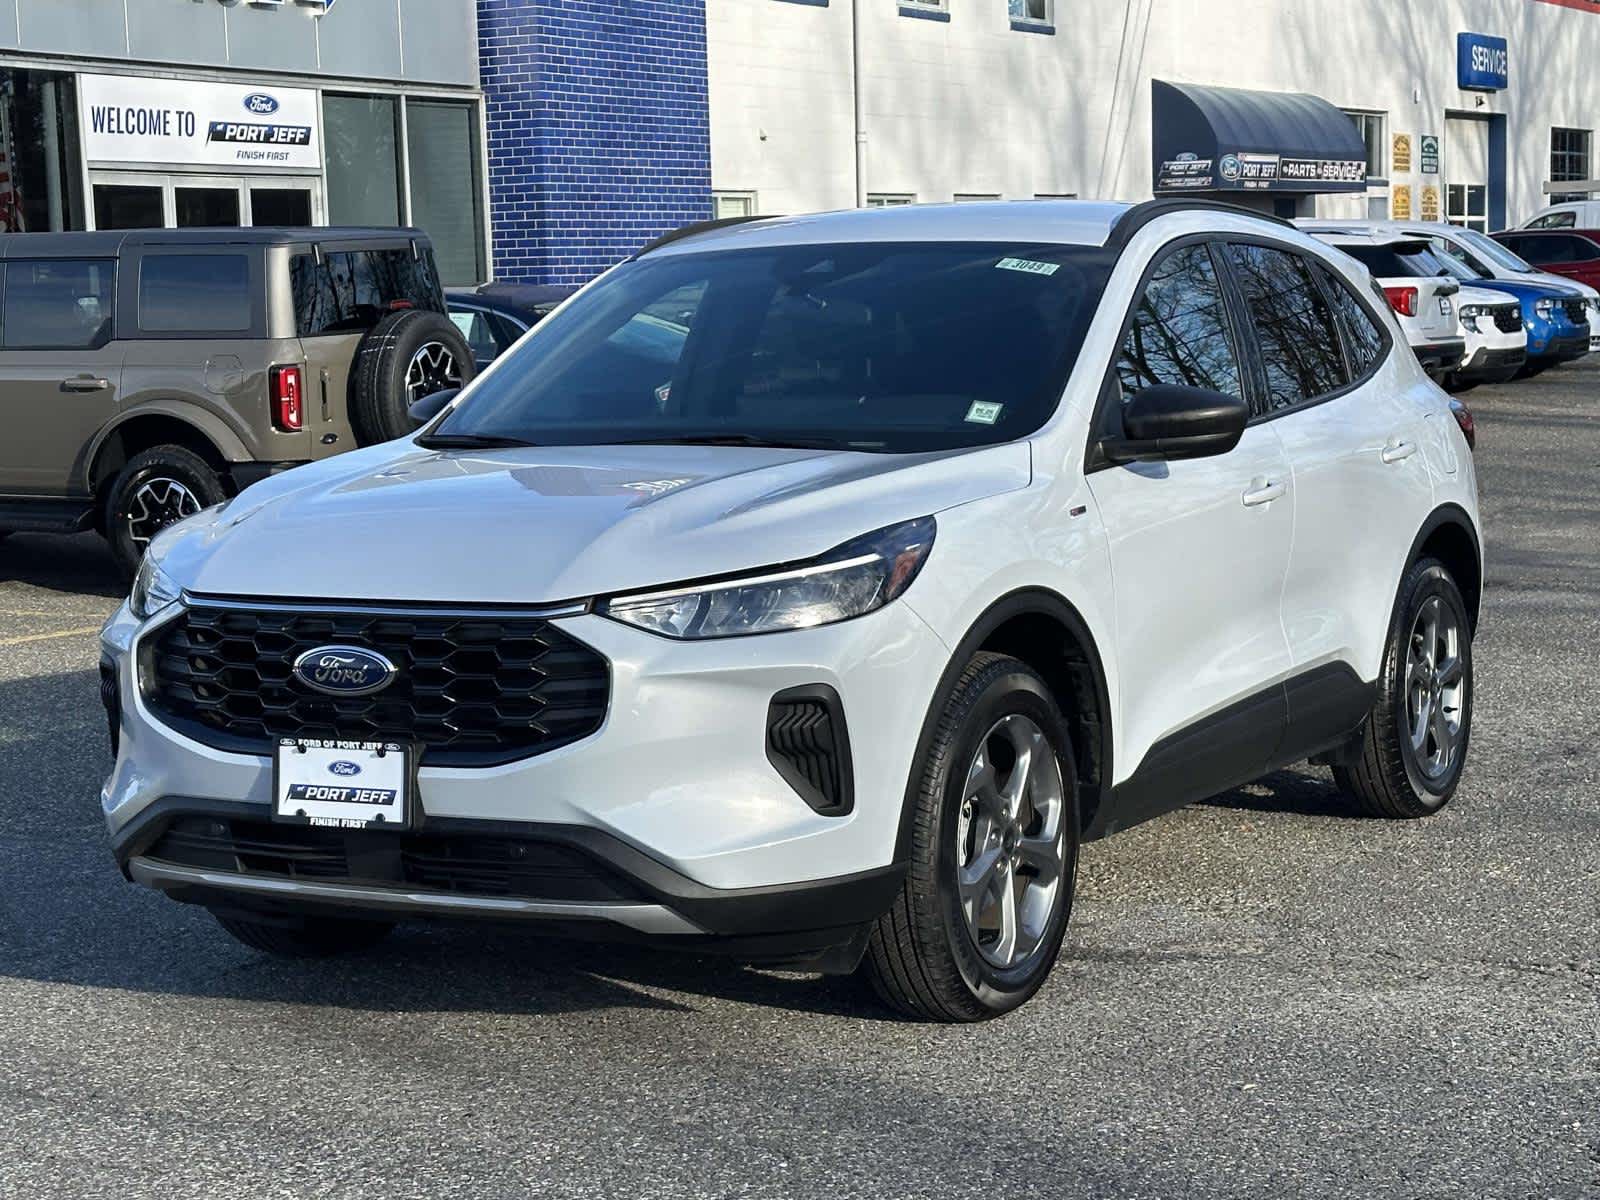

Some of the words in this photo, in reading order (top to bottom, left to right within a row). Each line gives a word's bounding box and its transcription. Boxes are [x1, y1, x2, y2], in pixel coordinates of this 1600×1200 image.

[1472, 44, 1506, 76] SERVICE
[91, 105, 171, 136] WELCOME
[175, 110, 195, 137] TO
[225, 124, 269, 141] PORT
[269, 127, 307, 144] JEFF
[236, 150, 265, 160] FINISH
[266, 151, 290, 161] FIRST
[1242, 163, 1261, 177] PORT
[1260, 164, 1277, 177] JEFF
[1288, 163, 1316, 177] PARTS
[1323, 165, 1357, 177] SERVICE
[315, 655, 369, 684] Ford
[298, 738, 322, 748] FORD
[322, 739, 335, 748] OF
[336, 740, 361, 749] PORT
[361, 742, 383, 751] JEFF
[305, 786, 350, 801] PORT
[351, 789, 392, 804] JEFF
[341, 819, 368, 829] FIRST
